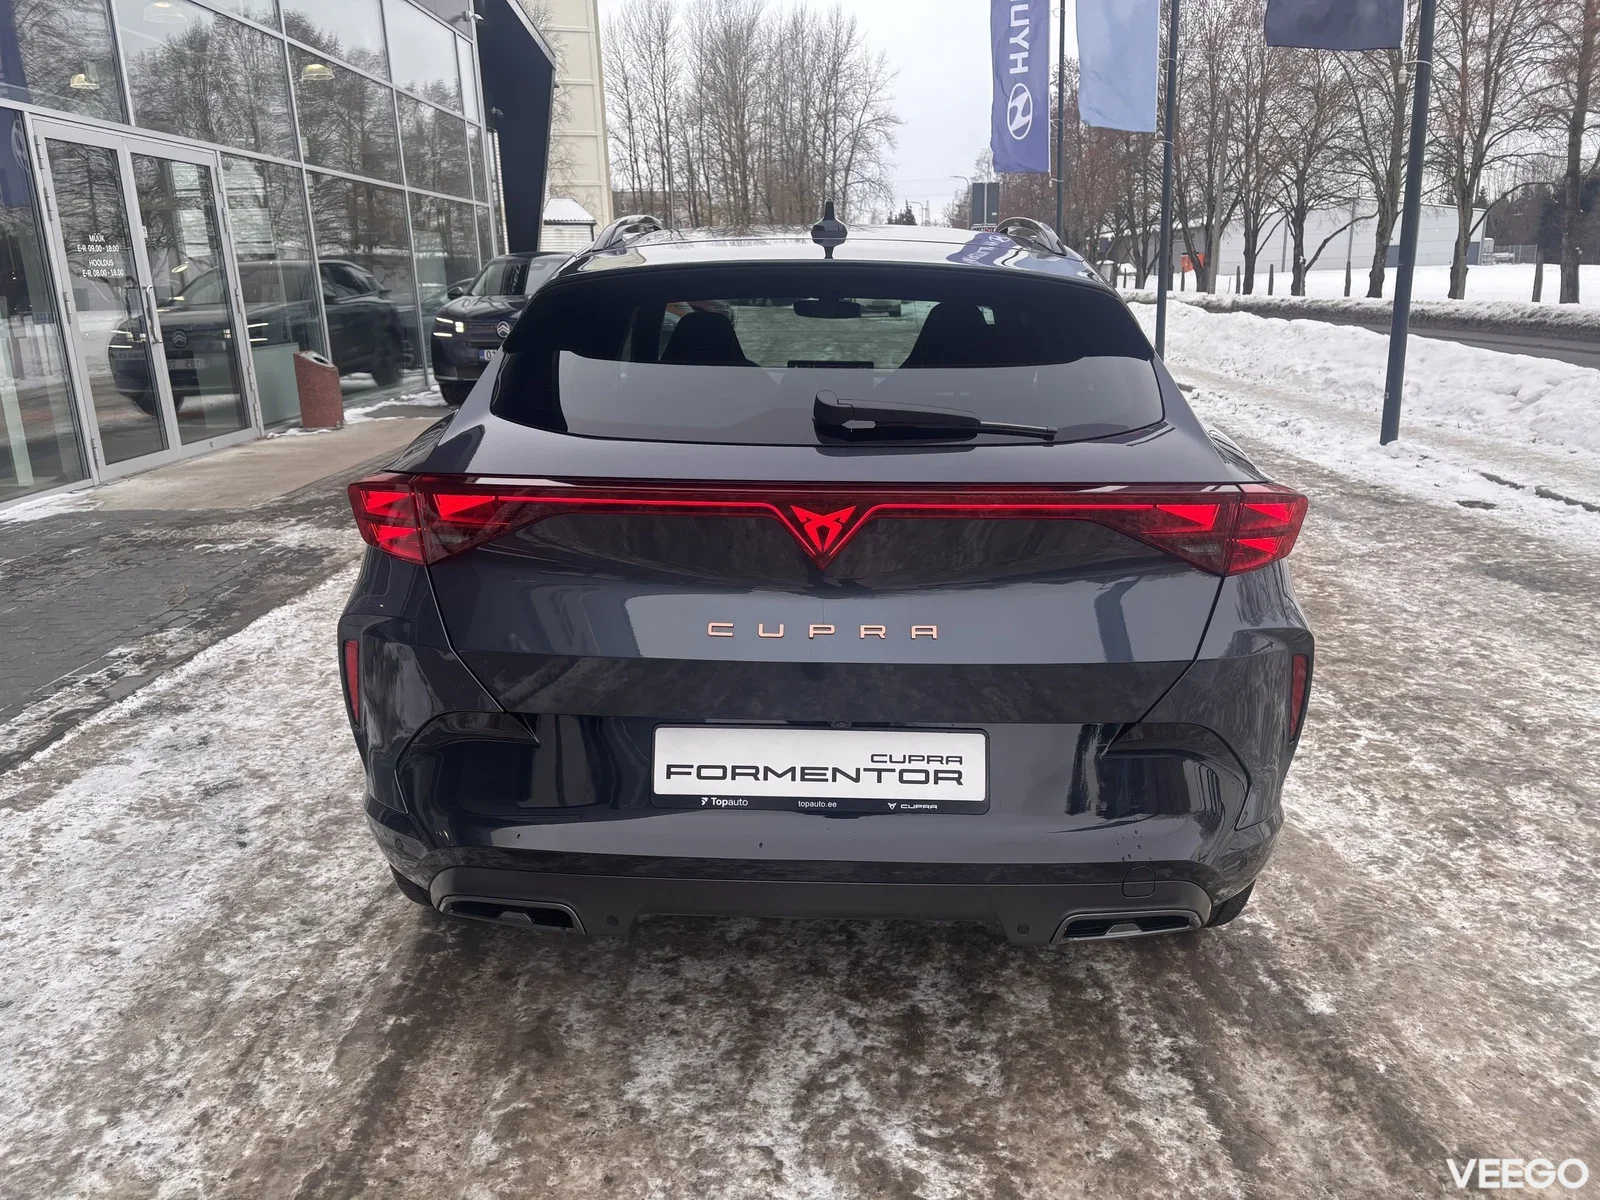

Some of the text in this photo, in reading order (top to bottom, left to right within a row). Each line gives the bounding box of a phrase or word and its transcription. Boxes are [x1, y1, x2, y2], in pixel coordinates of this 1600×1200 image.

[88, 233, 106, 242] MÜÜK
[77, 244, 87, 252] E-R
[87, 244, 102, 252] 09.00
[105, 244, 120, 252] 18.00
[88, 259, 114, 267] HOOLDUS
[92, 269, 107, 277] 08.00
[707, 622, 938, 640] CUPRA
[870, 753, 963, 766] CUPRA
[665, 764, 964, 786] FORMENTOR
[710, 797, 749, 808] Topauto
[797, 800, 838, 809] topauto.ee
